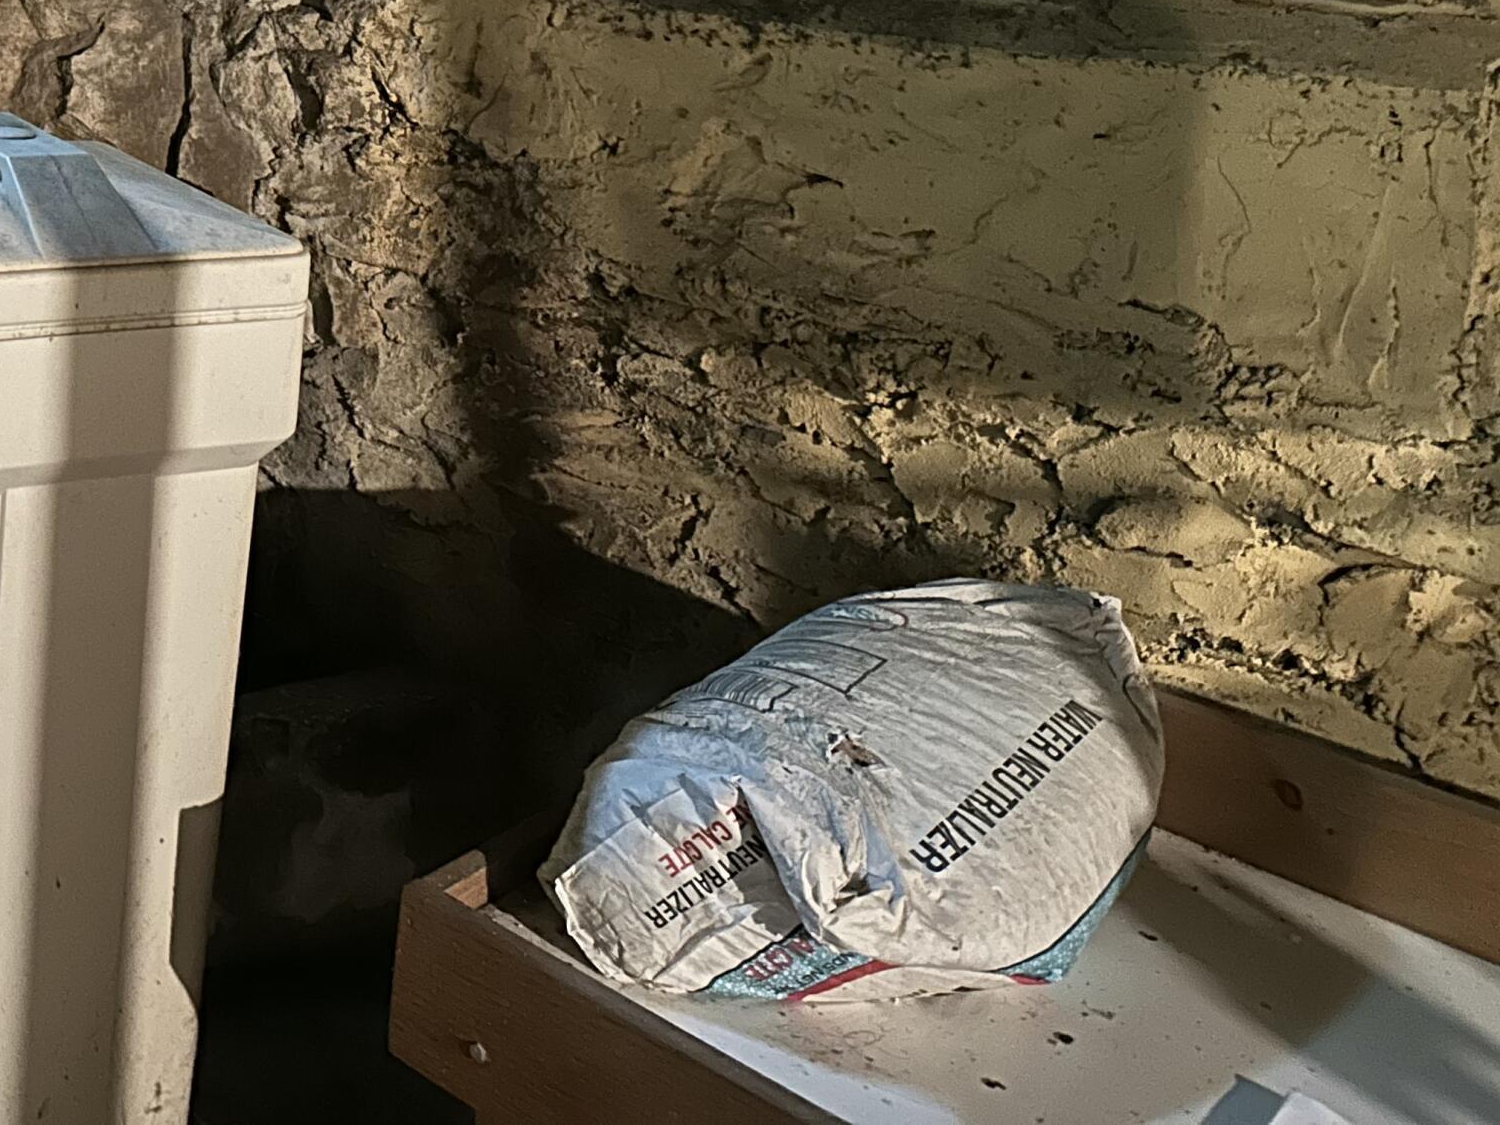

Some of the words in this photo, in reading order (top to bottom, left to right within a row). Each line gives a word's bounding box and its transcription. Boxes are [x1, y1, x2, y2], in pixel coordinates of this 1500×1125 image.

[1025, 699, 1103, 762] WATER
[658, 820, 733, 878] CALCITE
[908, 746, 1052, 873] NEUTRALIZER
[644, 834, 767, 929] NEUTRALIZER
